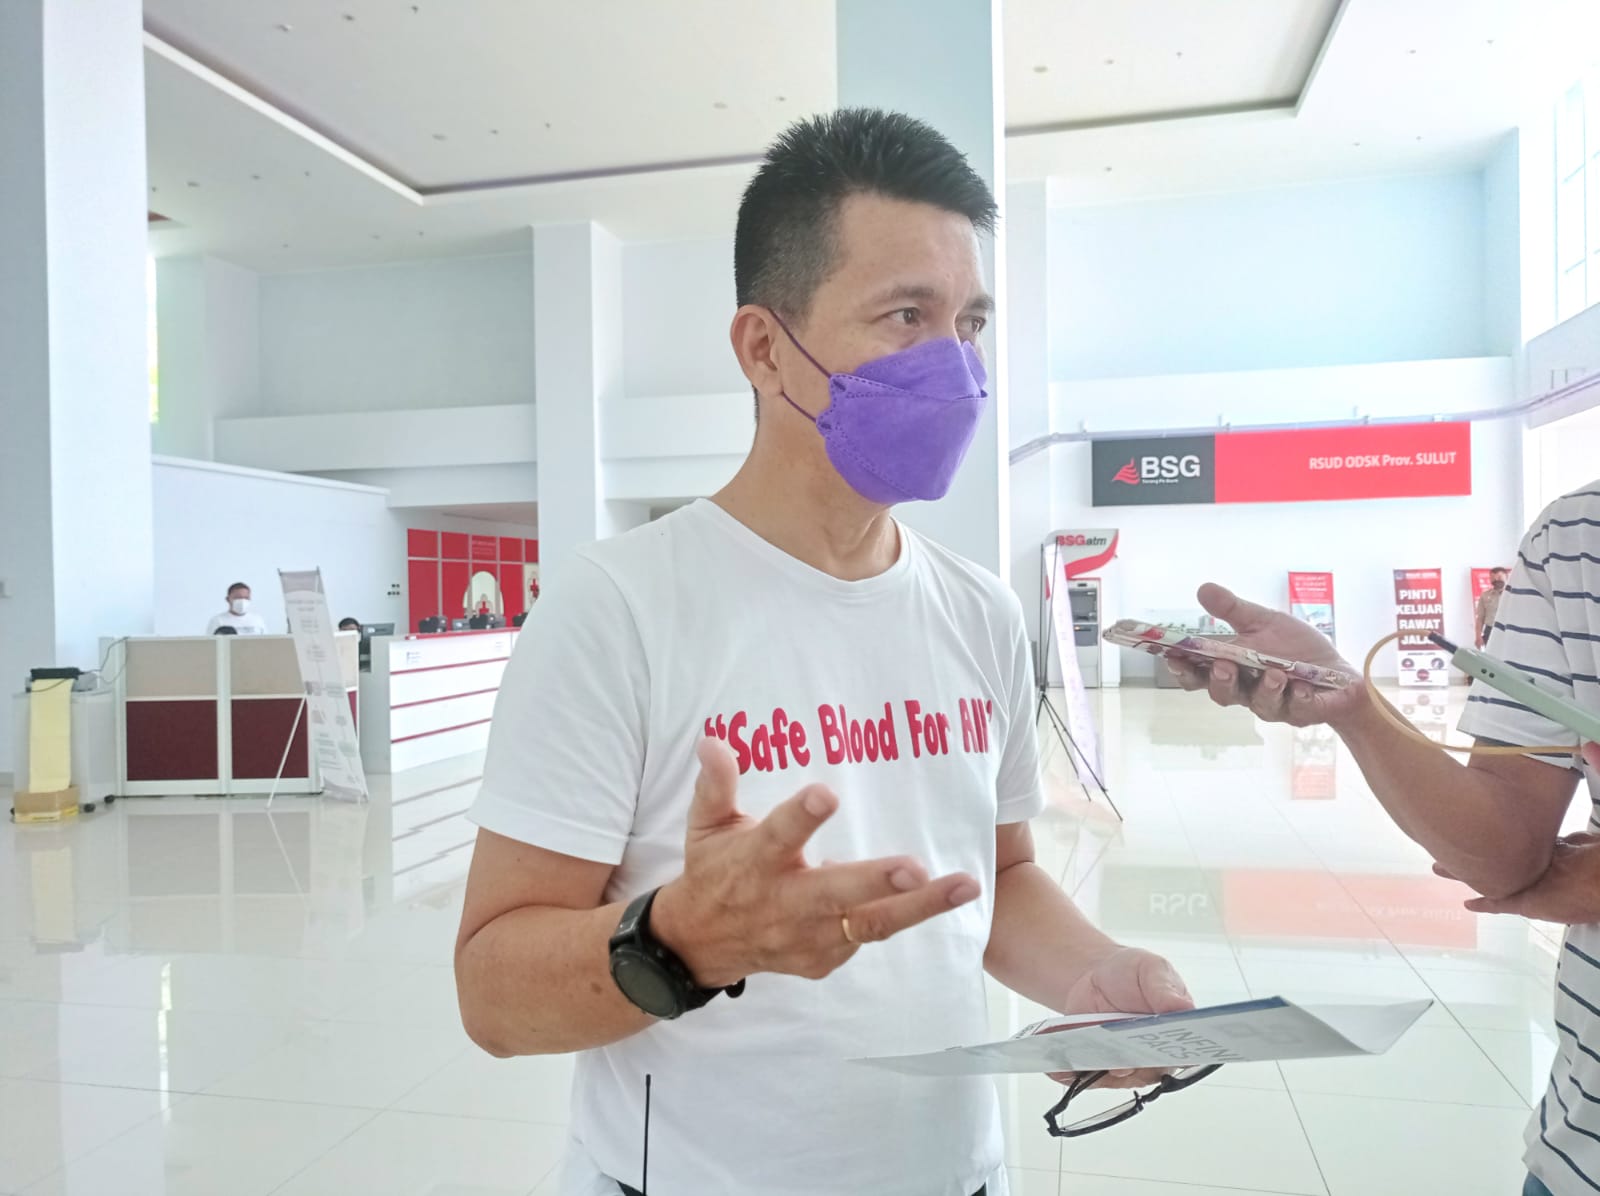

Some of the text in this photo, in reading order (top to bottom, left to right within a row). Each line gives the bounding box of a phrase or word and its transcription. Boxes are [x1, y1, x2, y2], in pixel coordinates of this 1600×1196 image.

[1141, 455, 1201, 478] BSG
[1308, 451, 1456, 471] RSUD ODSK Prov. SULUT
[1399, 589, 1437, 600] PINTU
[1395, 603, 1443, 615] KELUAR
[1398, 618, 1441, 629] RAWAT
[1401, 634, 1437, 645] JALA
[817, 701, 899, 766] Blood
[905, 699, 951, 758] For
[1127, 1033, 1201, 1060] PACS
